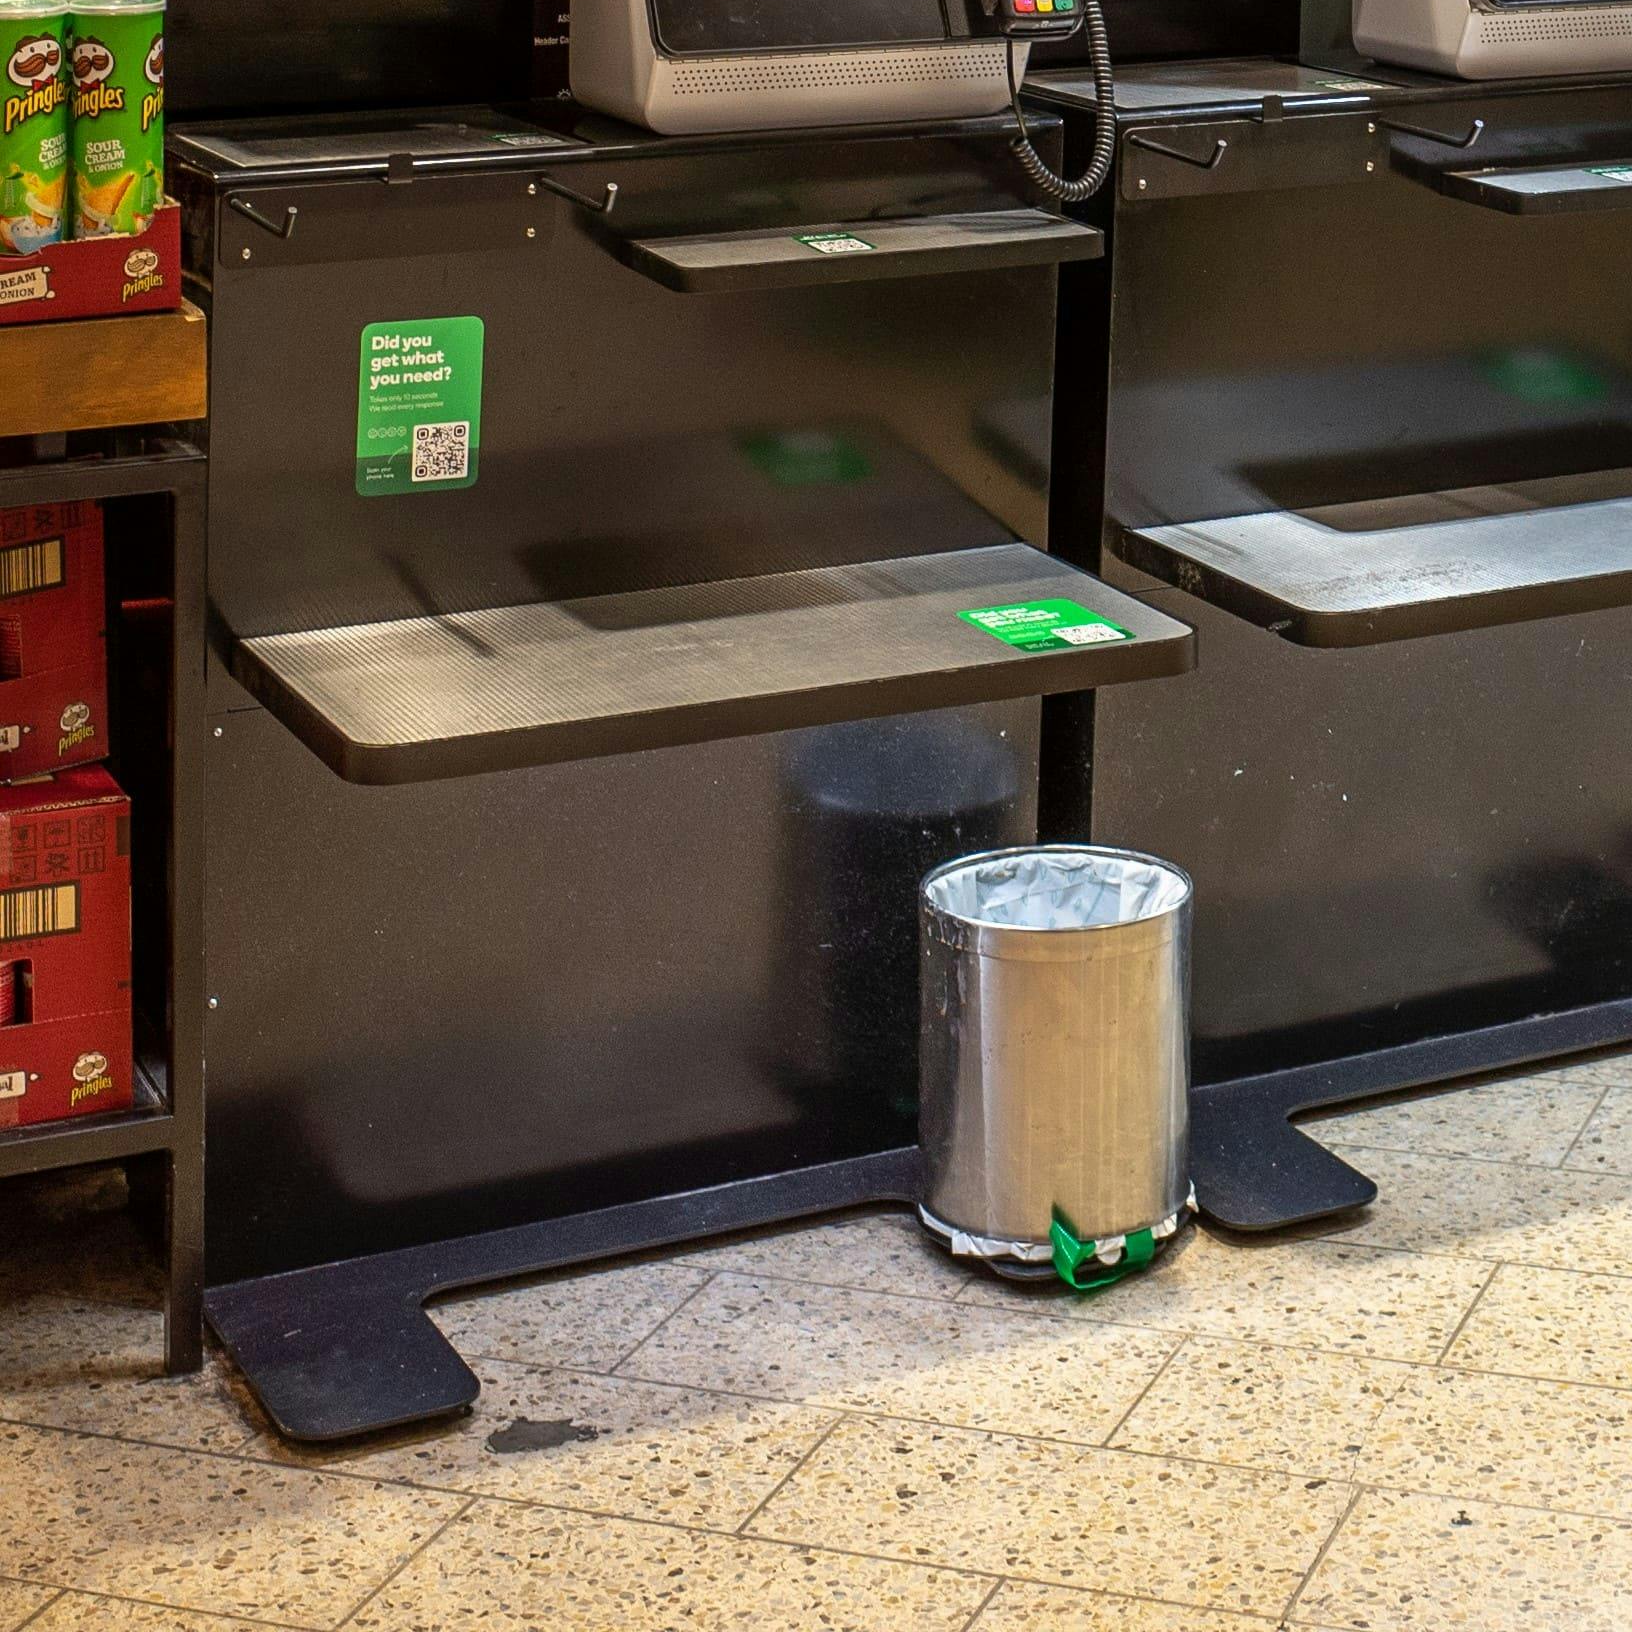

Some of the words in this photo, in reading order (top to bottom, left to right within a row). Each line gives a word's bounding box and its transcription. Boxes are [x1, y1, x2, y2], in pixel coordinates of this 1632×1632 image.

[73, 82, 124, 118] ringles
[86, 139, 121, 155] SOUR
[85, 149, 126, 165] CREAM
[95, 161, 124, 172] ONION
[123, 273, 164, 303] Pringles
[372, 335, 399, 351] Did
[402, 335, 432, 352] you
[371, 354, 399, 372] get
[402, 350, 444, 366] what
[370, 375, 400, 389] you
[403, 366, 452, 383] need?
[389, 394, 403, 403] only
[398, 403, 414, 412] every
[58, 724, 95, 756] Pringles
[71, 1074, 113, 1108] Pringles
